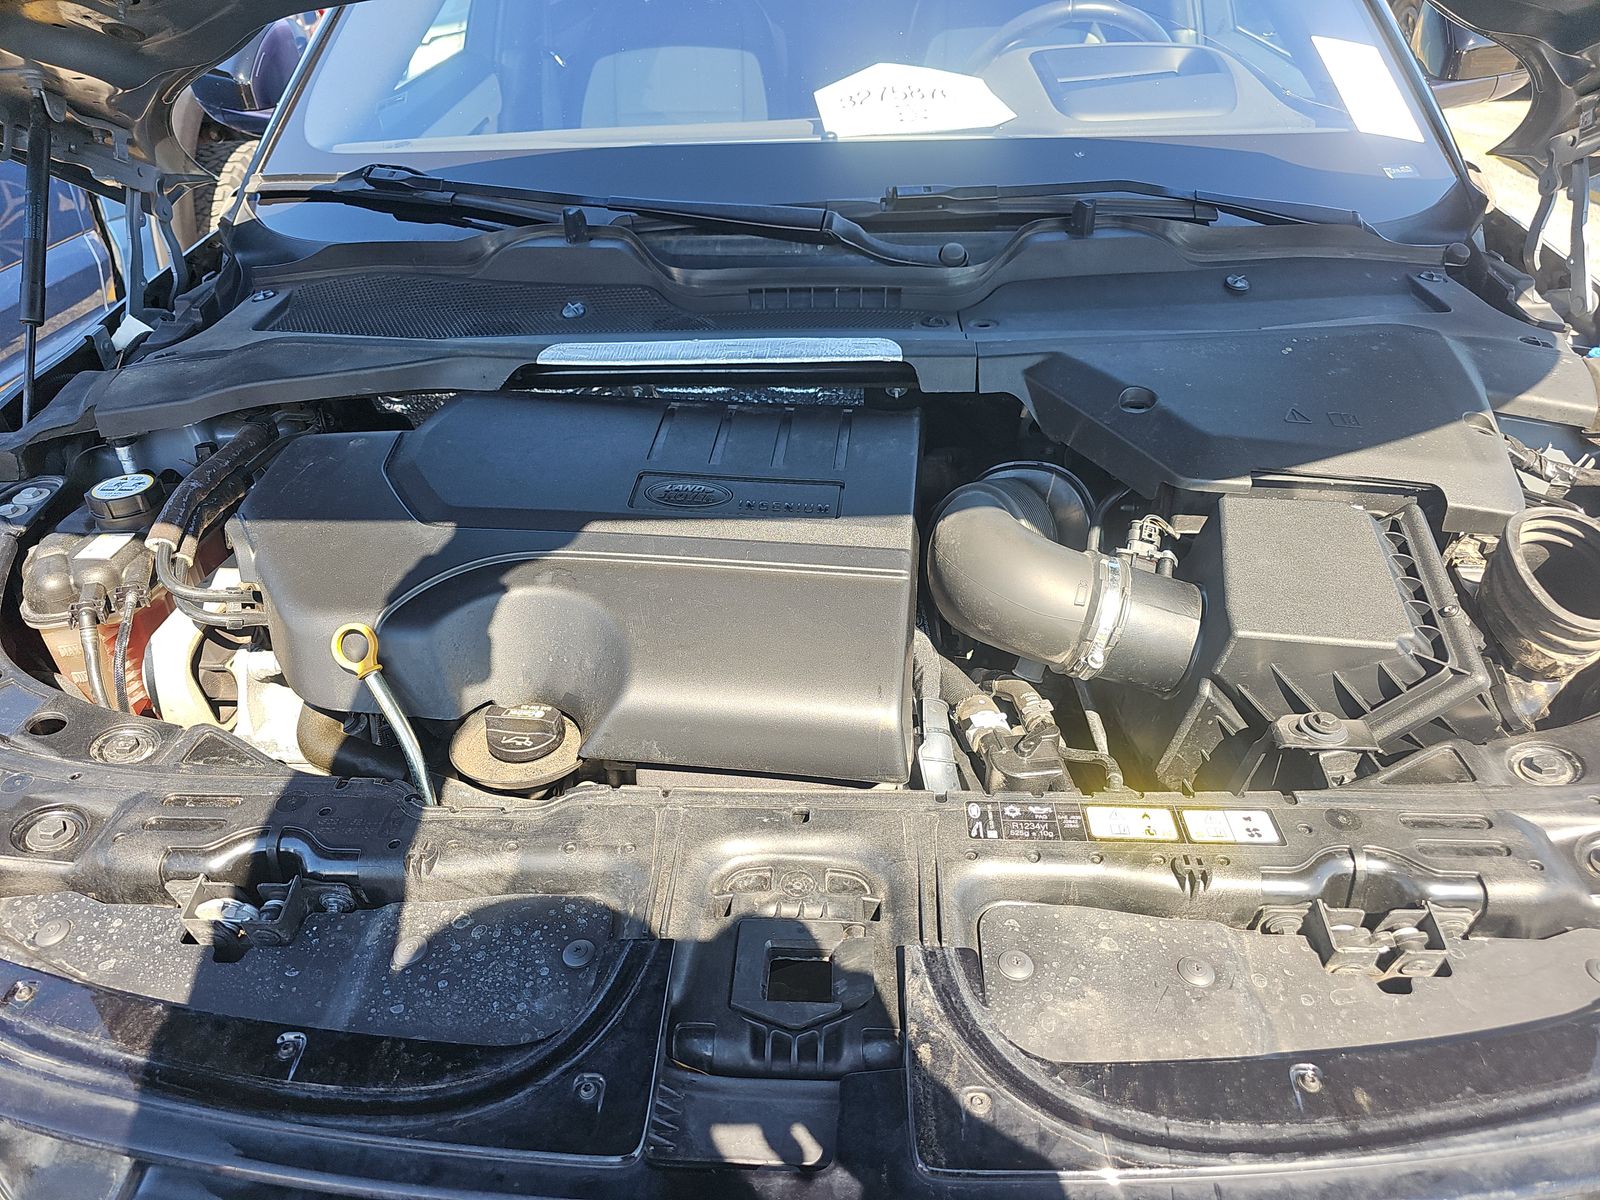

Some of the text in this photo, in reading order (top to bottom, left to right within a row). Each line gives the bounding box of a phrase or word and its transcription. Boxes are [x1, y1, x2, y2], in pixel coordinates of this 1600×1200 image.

[664, 484, 708, 493] LAND
[738, 499, 830, 513] INGENIUM
[1011, 821, 1049, 831] R1234yf
[1039, 830, 1054, 838] 10g
